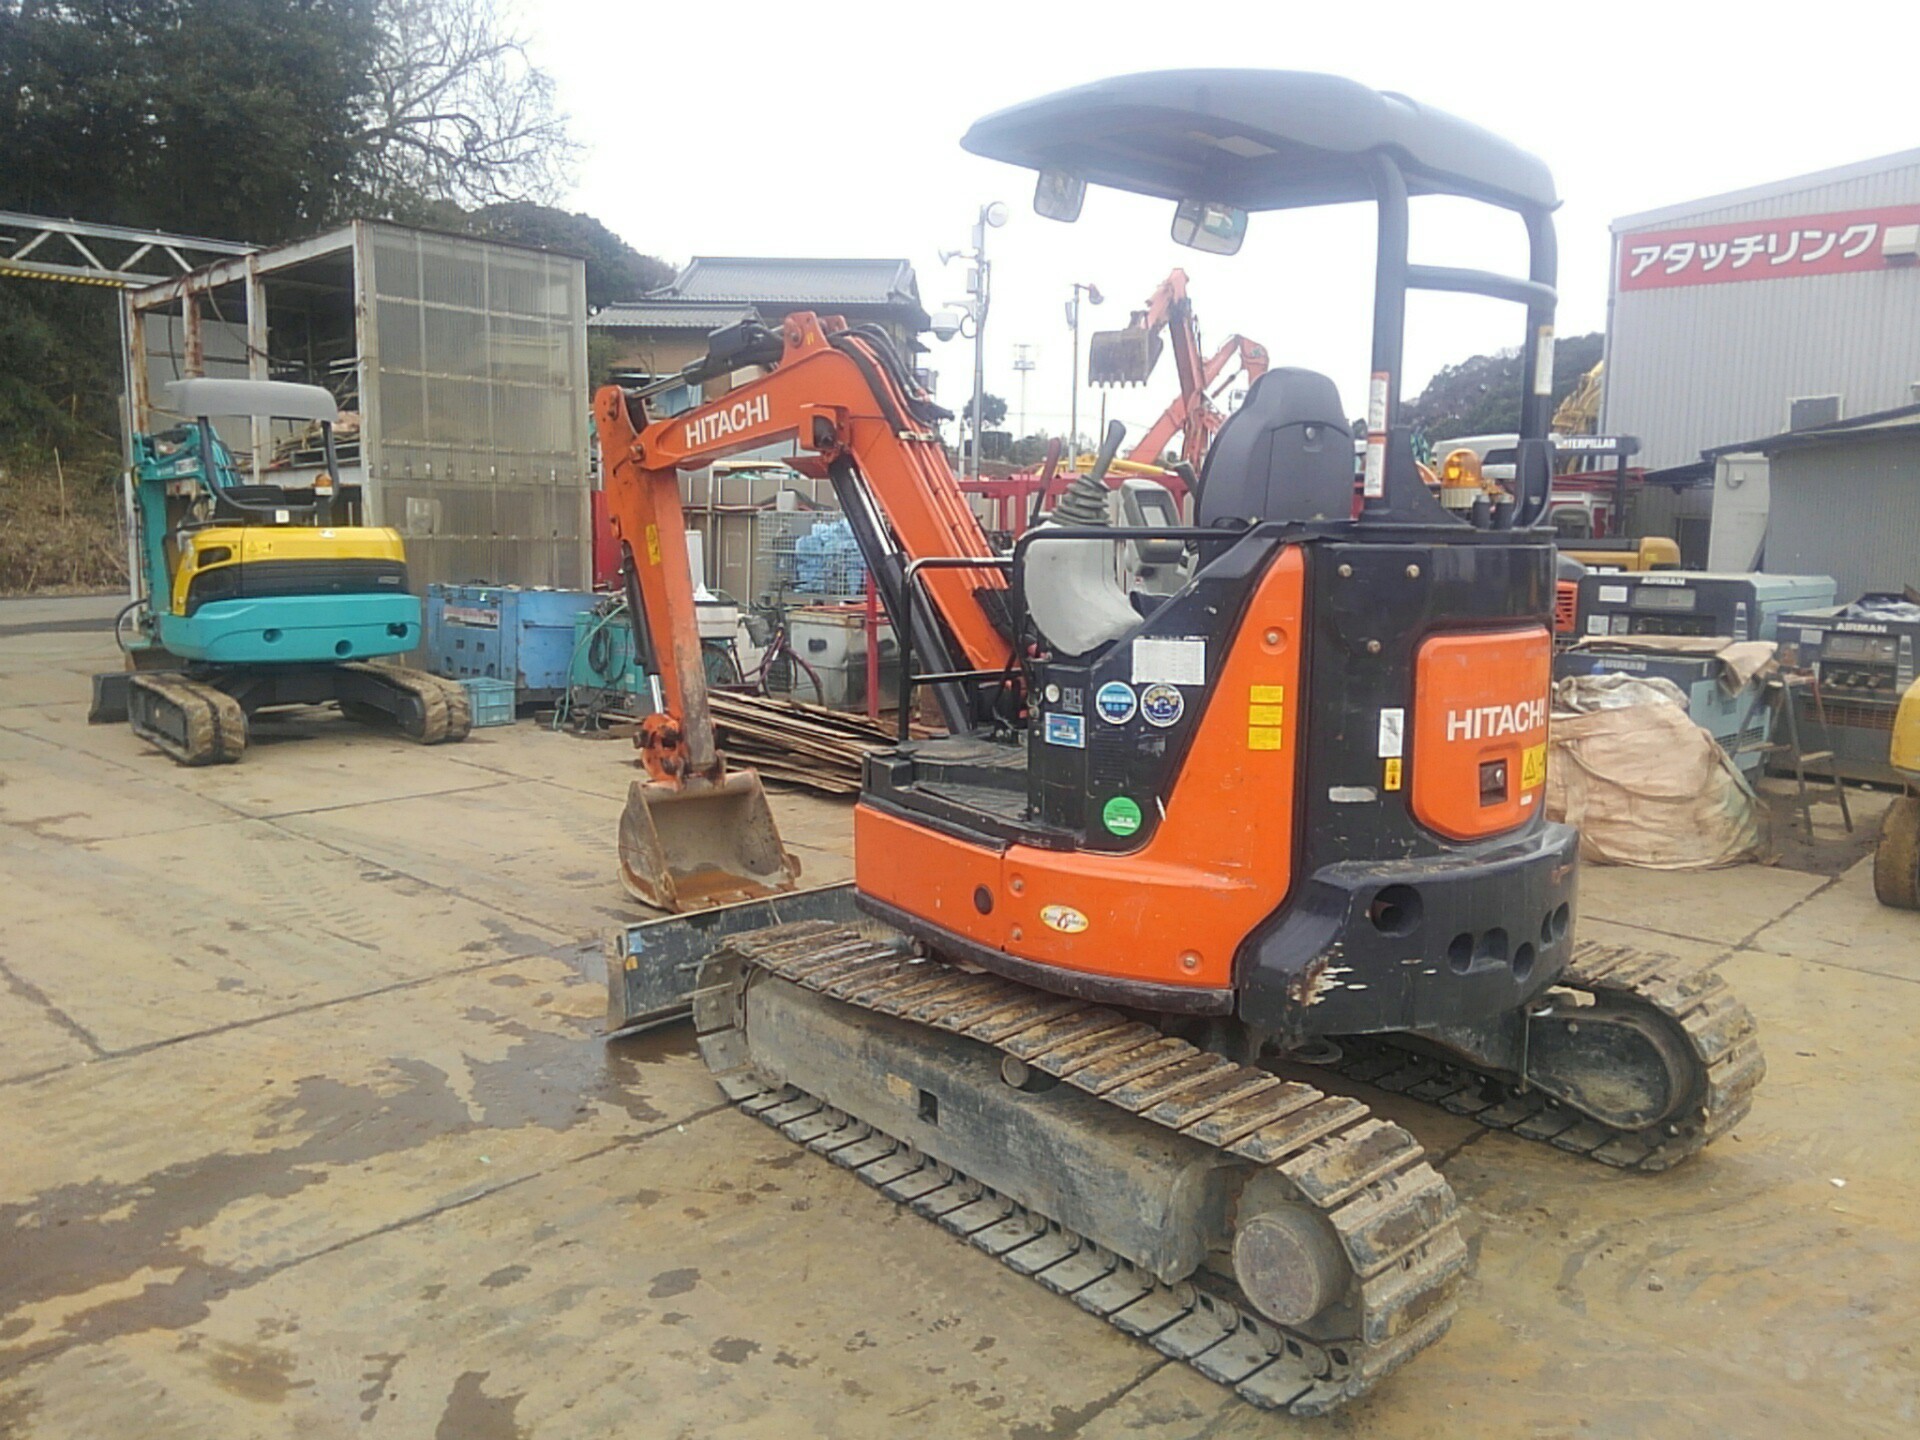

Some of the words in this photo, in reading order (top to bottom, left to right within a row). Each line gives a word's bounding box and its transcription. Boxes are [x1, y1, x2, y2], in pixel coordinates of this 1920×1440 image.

[1630, 223, 1878, 278] アタッチリンク
[685, 393, 769, 449] HITACHI
[1640, 577, 1686, 585] AIRMAN
[1835, 622, 1887, 633] AIRMAN
[1447, 698, 1545, 742] HITACHI
